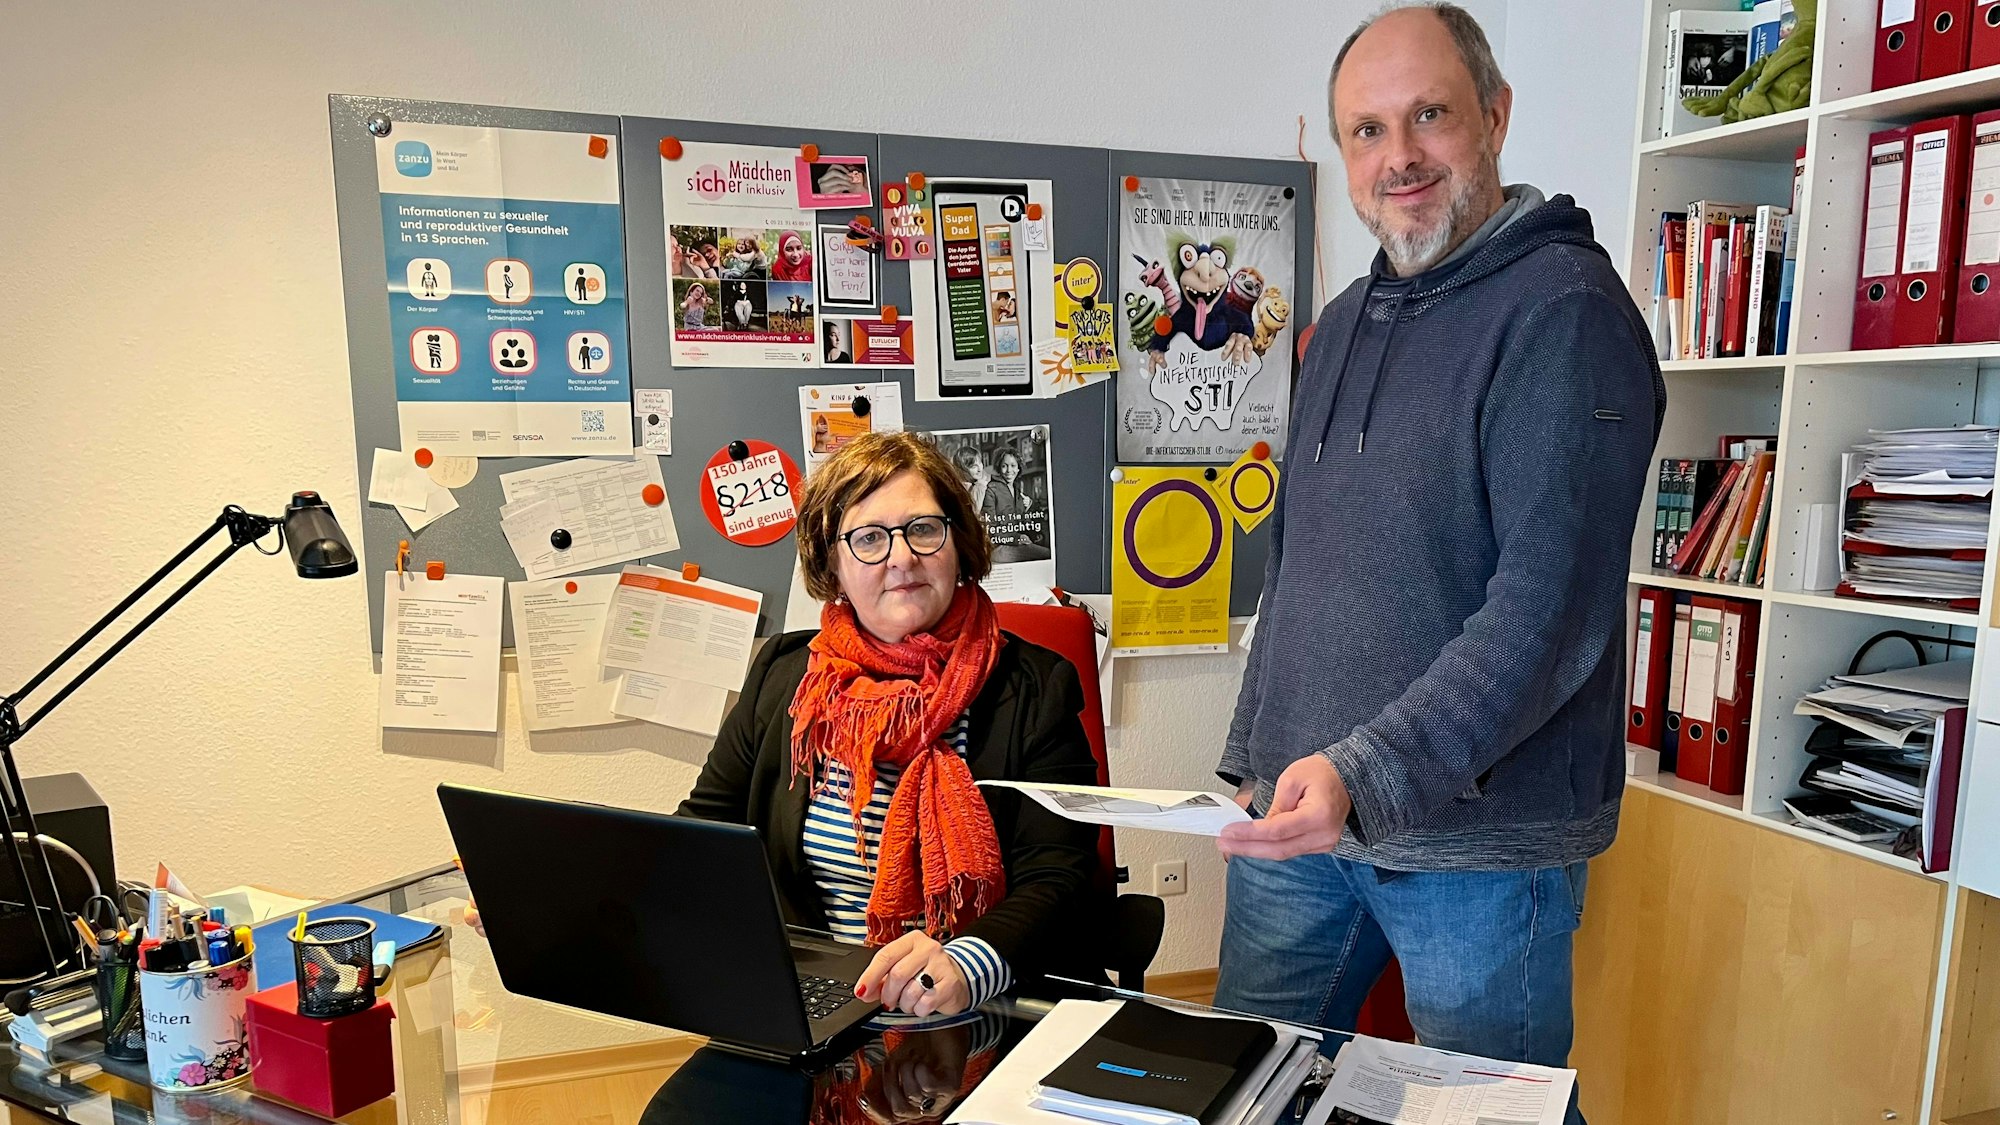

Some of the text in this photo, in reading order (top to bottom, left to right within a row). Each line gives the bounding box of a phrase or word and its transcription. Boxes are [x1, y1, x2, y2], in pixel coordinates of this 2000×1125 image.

[1923, 140, 1944, 150] OFFICE
[398, 154, 430, 164] zanzu
[729, 160, 791, 182] Mädchen
[687, 170, 742, 193] sicher
[746, 184, 786, 195] inklusiv
[398, 206, 549, 222] Informationen zu sexueller
[893, 204, 921, 217] VIVA
[902, 216, 914, 226] LA
[945, 214, 973, 224] Super
[1134, 208, 1280, 231] SIE SIND HIER. MITTEN UNTER UNS.
[400, 220, 568, 236] und reproduktiver Gesundheit
[892, 226, 925, 237] VULVA
[951, 226, 970, 235] Dad
[401, 232, 489, 246] in 13 Sprachen.
[842, 280, 864, 293] Fun!
[678, 333, 791, 342] www.mädchensicherinklusiv-nrw.de
[1179, 351, 1199, 364] DIE
[1160, 362, 1248, 385] INFEKTASTISCHEN
[1184, 380, 1234, 415] STI
[1249, 403, 1274, 413] Vielleicht
[1242, 415, 1256, 424] auch
[1241, 426, 1279, 434] deiner Nähe?
[712, 454, 776, 480] 150 Jahre
[717, 472, 789, 518] §218
[728, 508, 794, 533] sind genug
[986, 521, 1041, 534] fersüchtig
[1696, 624, 1713, 633] OTTO
[144, 1008, 191, 1024] lichen
